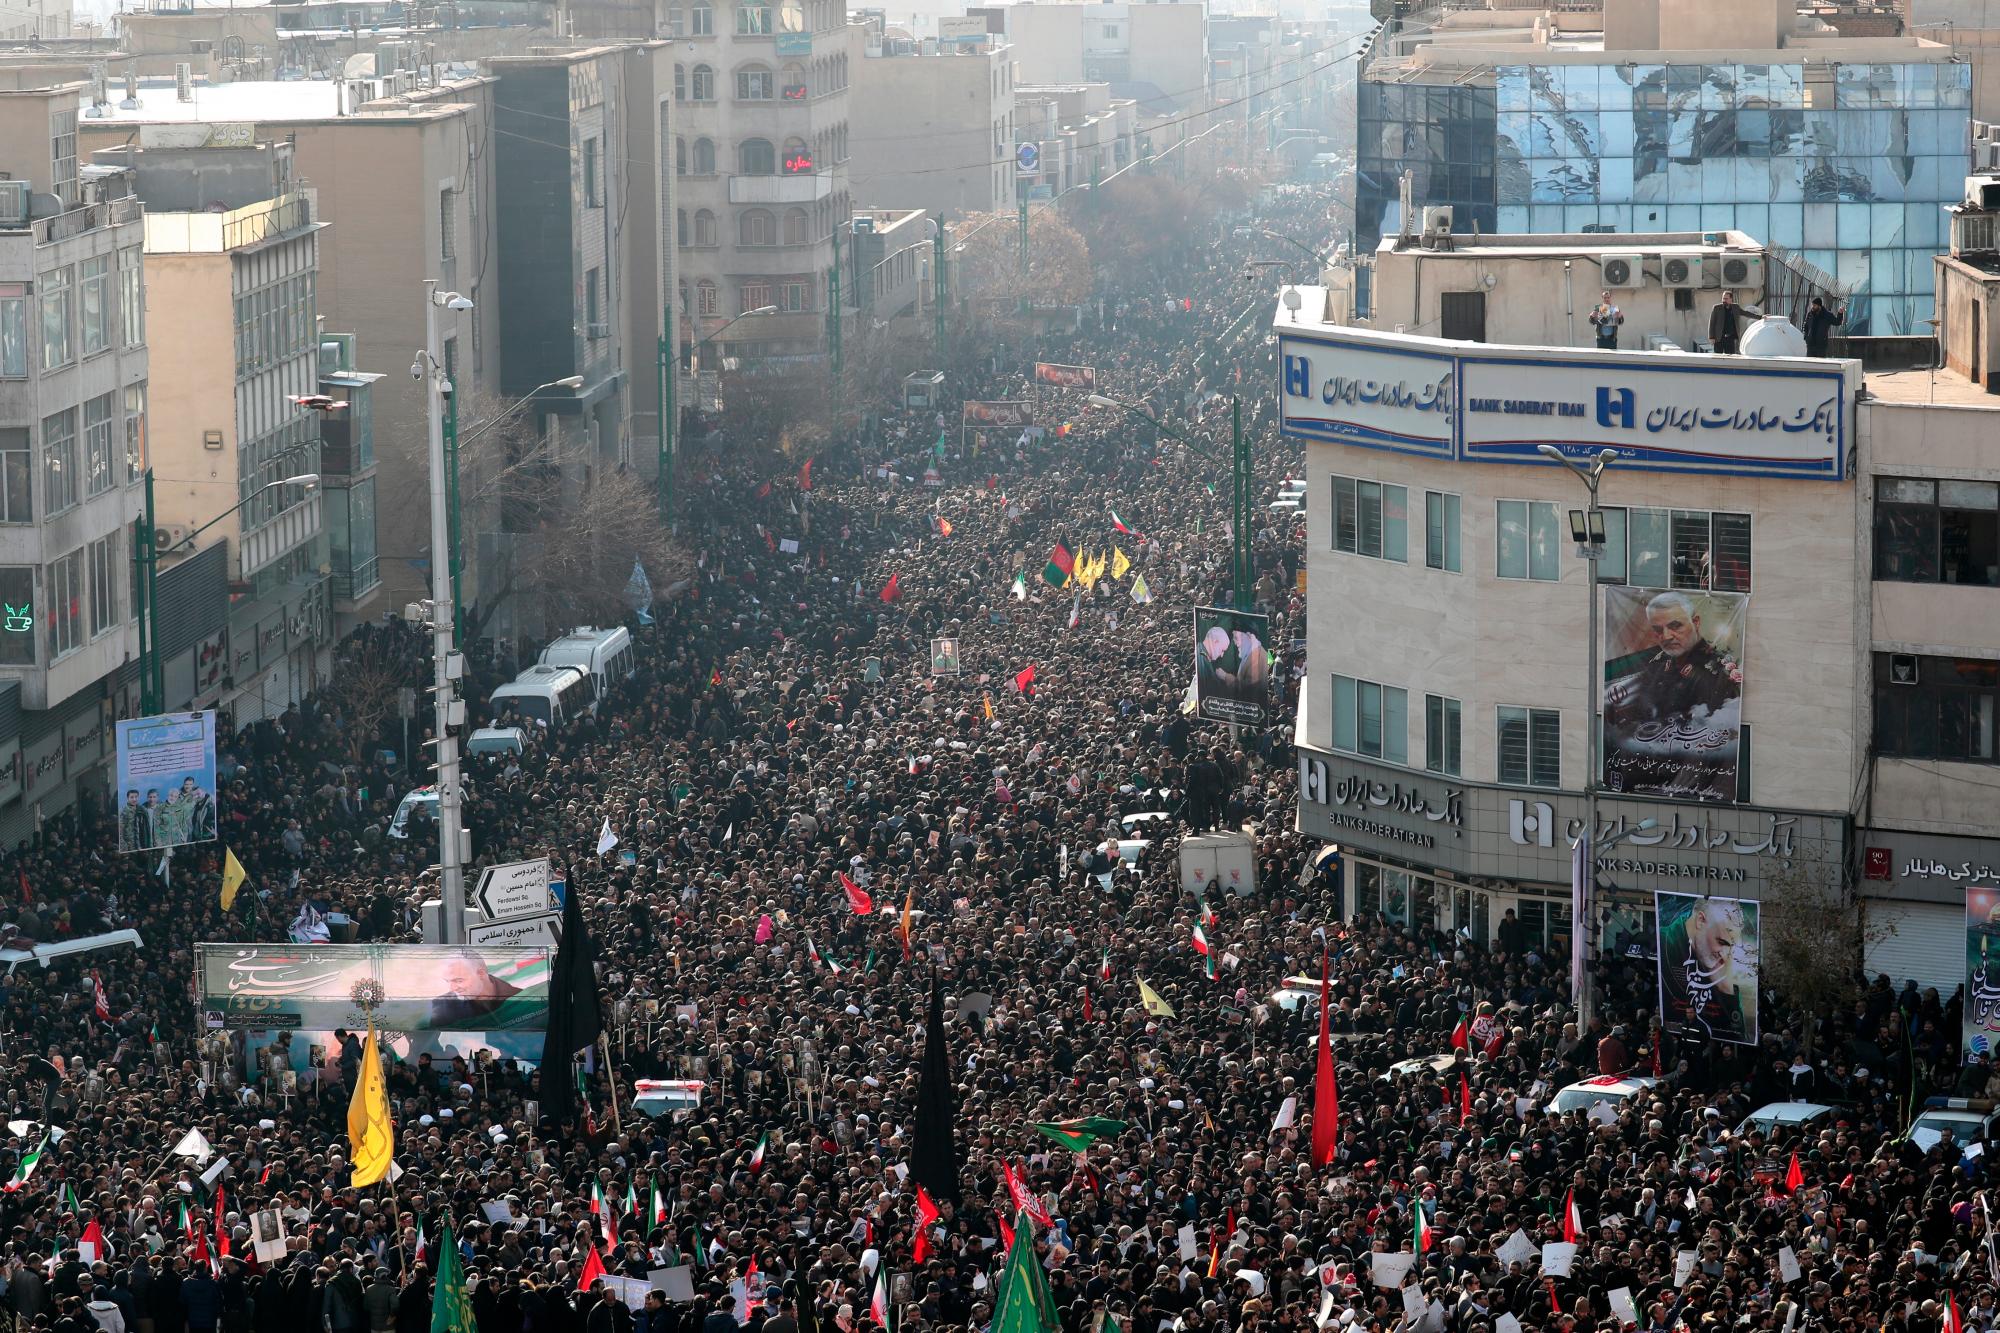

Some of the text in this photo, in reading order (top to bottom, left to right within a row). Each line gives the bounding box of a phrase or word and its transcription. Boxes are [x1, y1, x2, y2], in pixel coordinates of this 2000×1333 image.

[1323, 373, 1453, 424] بانک صادرات ایران
[1470, 398, 1586, 417] BANK SADERAT IRAN
[1646, 396, 1836, 443] بانک صادرات ایران
[1582, 446, 1593, 455] کد
[1620, 449, 1637, 460] شعبه
[1336, 775, 1463, 838] بانک صادرات ایران
[1732, 813, 1798, 869] بانک
[511, 866, 537, 878] فردوسی
[1901, 859, 1947, 879] هایلار
[1948, 862, 1989, 882] ترکی
[506, 881, 537, 893] امام حسین
[478, 928, 505, 943] اسلامی
[506, 925, 535, 938] جمهوری
[300, 953, 337, 964] سردار
